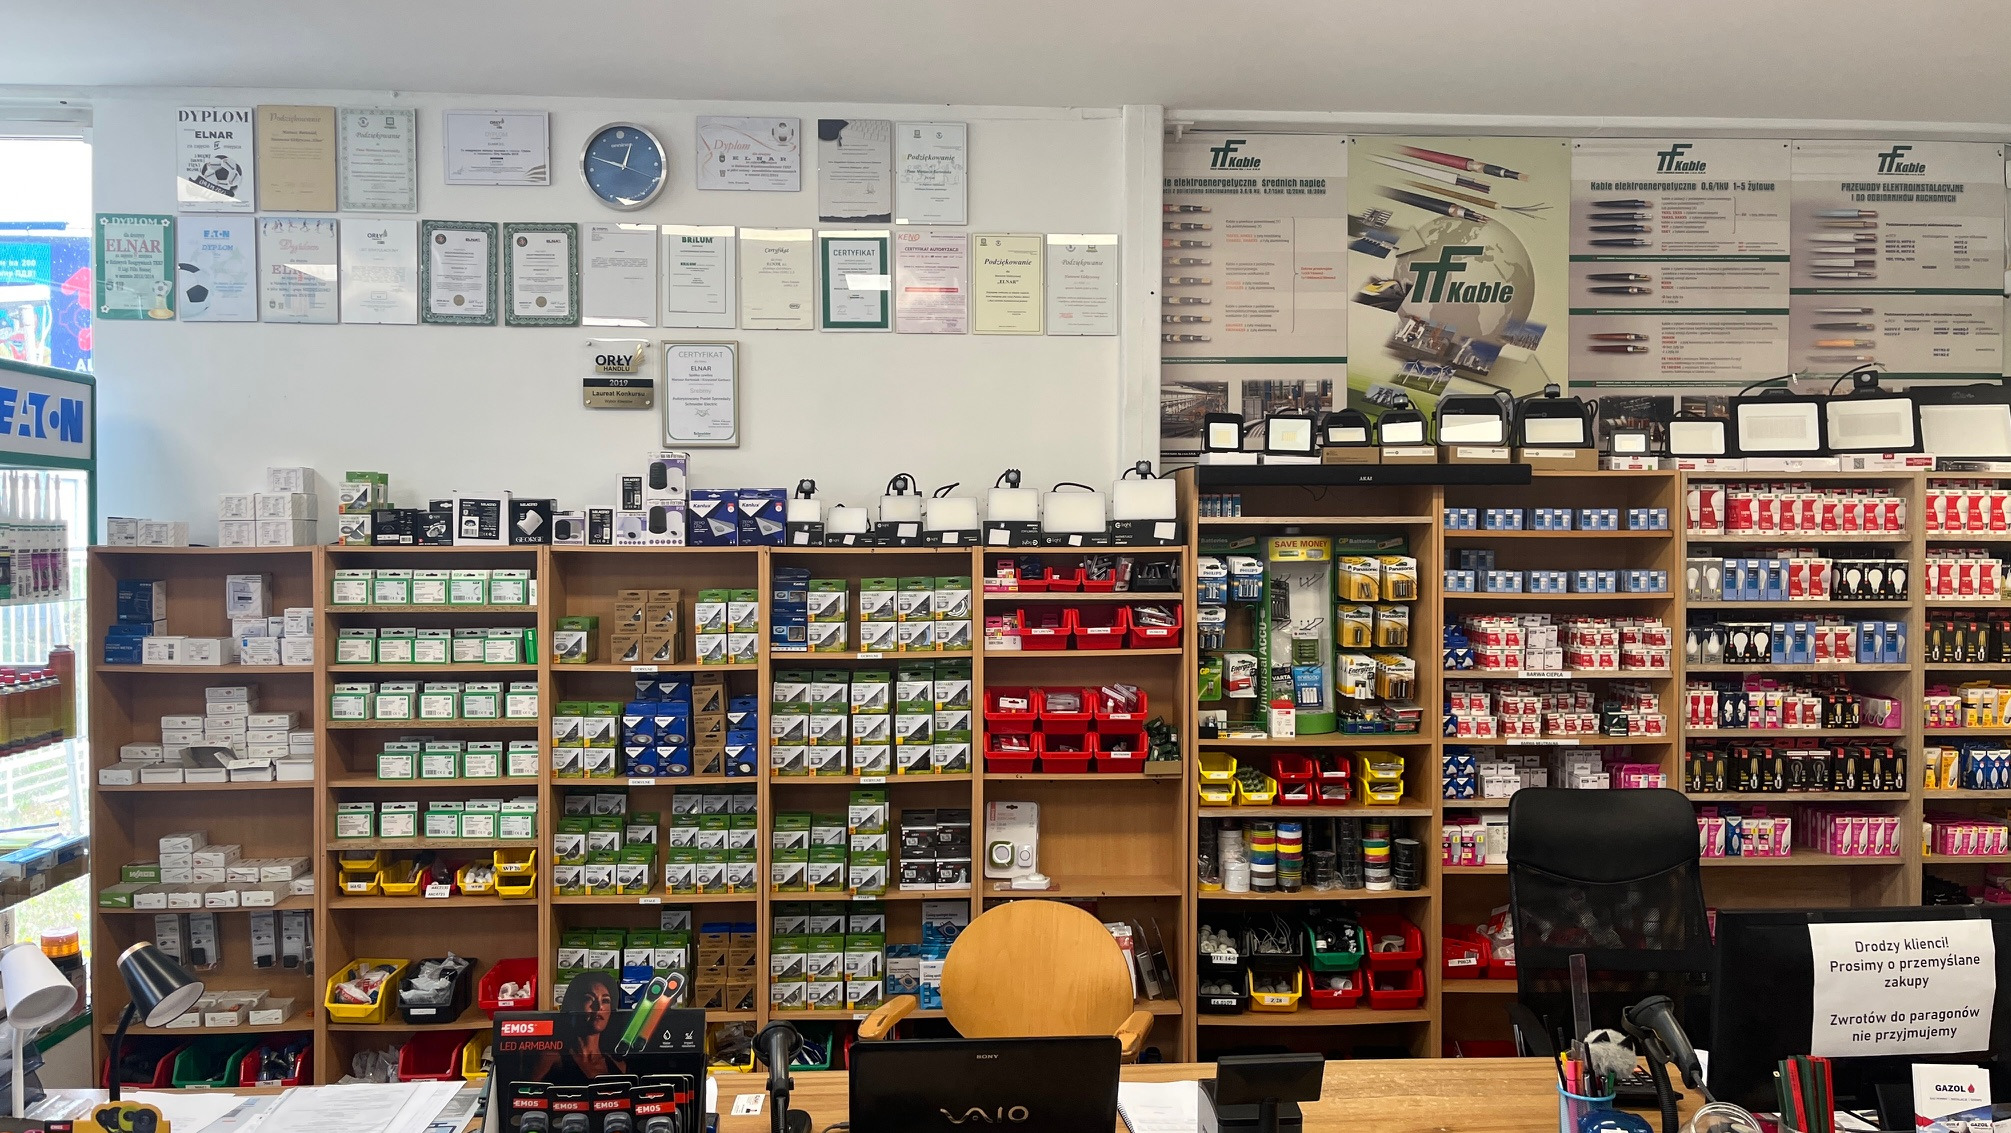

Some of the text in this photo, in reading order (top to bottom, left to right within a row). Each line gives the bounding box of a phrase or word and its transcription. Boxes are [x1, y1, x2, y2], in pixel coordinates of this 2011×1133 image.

[178, 110, 249, 123] DYPLOM
[270, 112, 321, 123] Podziękowanie
[195, 131, 233, 139] ELNAR
[714, 140, 750, 152] Dyplom
[906, 153, 955, 162] Podziękowanie
[1228, 157, 1262, 168] Kable
[1674, 161, 1706, 171] Kable
[1895, 162, 1926, 173] Kable
[1174, 178, 1326, 188] elektroenergetyczne średnich napięć
[1590, 180, 1775, 192] Kable elektroenergetyczne 0.6/1kV 1-5 żyłowe
[1841, 183, 1964, 192] PRZEWODY ELEKTROINSTALACYJNE
[1867, 194, 1913, 202] ODBIORNIKÓW
[106, 239, 162, 253] ELNAR
[984, 258, 1032, 266] Podziękowanie
[1062, 258, 1103, 266] Podziękowanie
[1447, 282, 1514, 303] Kable
[595, 355, 632, 366] ORŁY
[0, 387, 83, 443] EATON
[1230, 661, 1256, 672] Energizer
[1348, 664, 1374, 674] Energizer
[1297, 673, 1320, 681] eneloop
[1259, 657, 1267, 712] Universal
[1855, 937, 1949, 953] Drodzy klienci!
[1830, 954, 1980, 973] Prosimy o przemyślane
[1884, 976, 1929, 988] zakupy
[1830, 1006, 1980, 1026] Zwrotów do paragonów
[503, 1024, 535, 1033] EMOS
[1852, 1027, 1957, 1042] nie przyjmujemy
[500, 1041, 564, 1051] LED ARMBAND
[638, 1105, 661, 1113] EMOS
[940, 1105, 1029, 1124] VAIO
